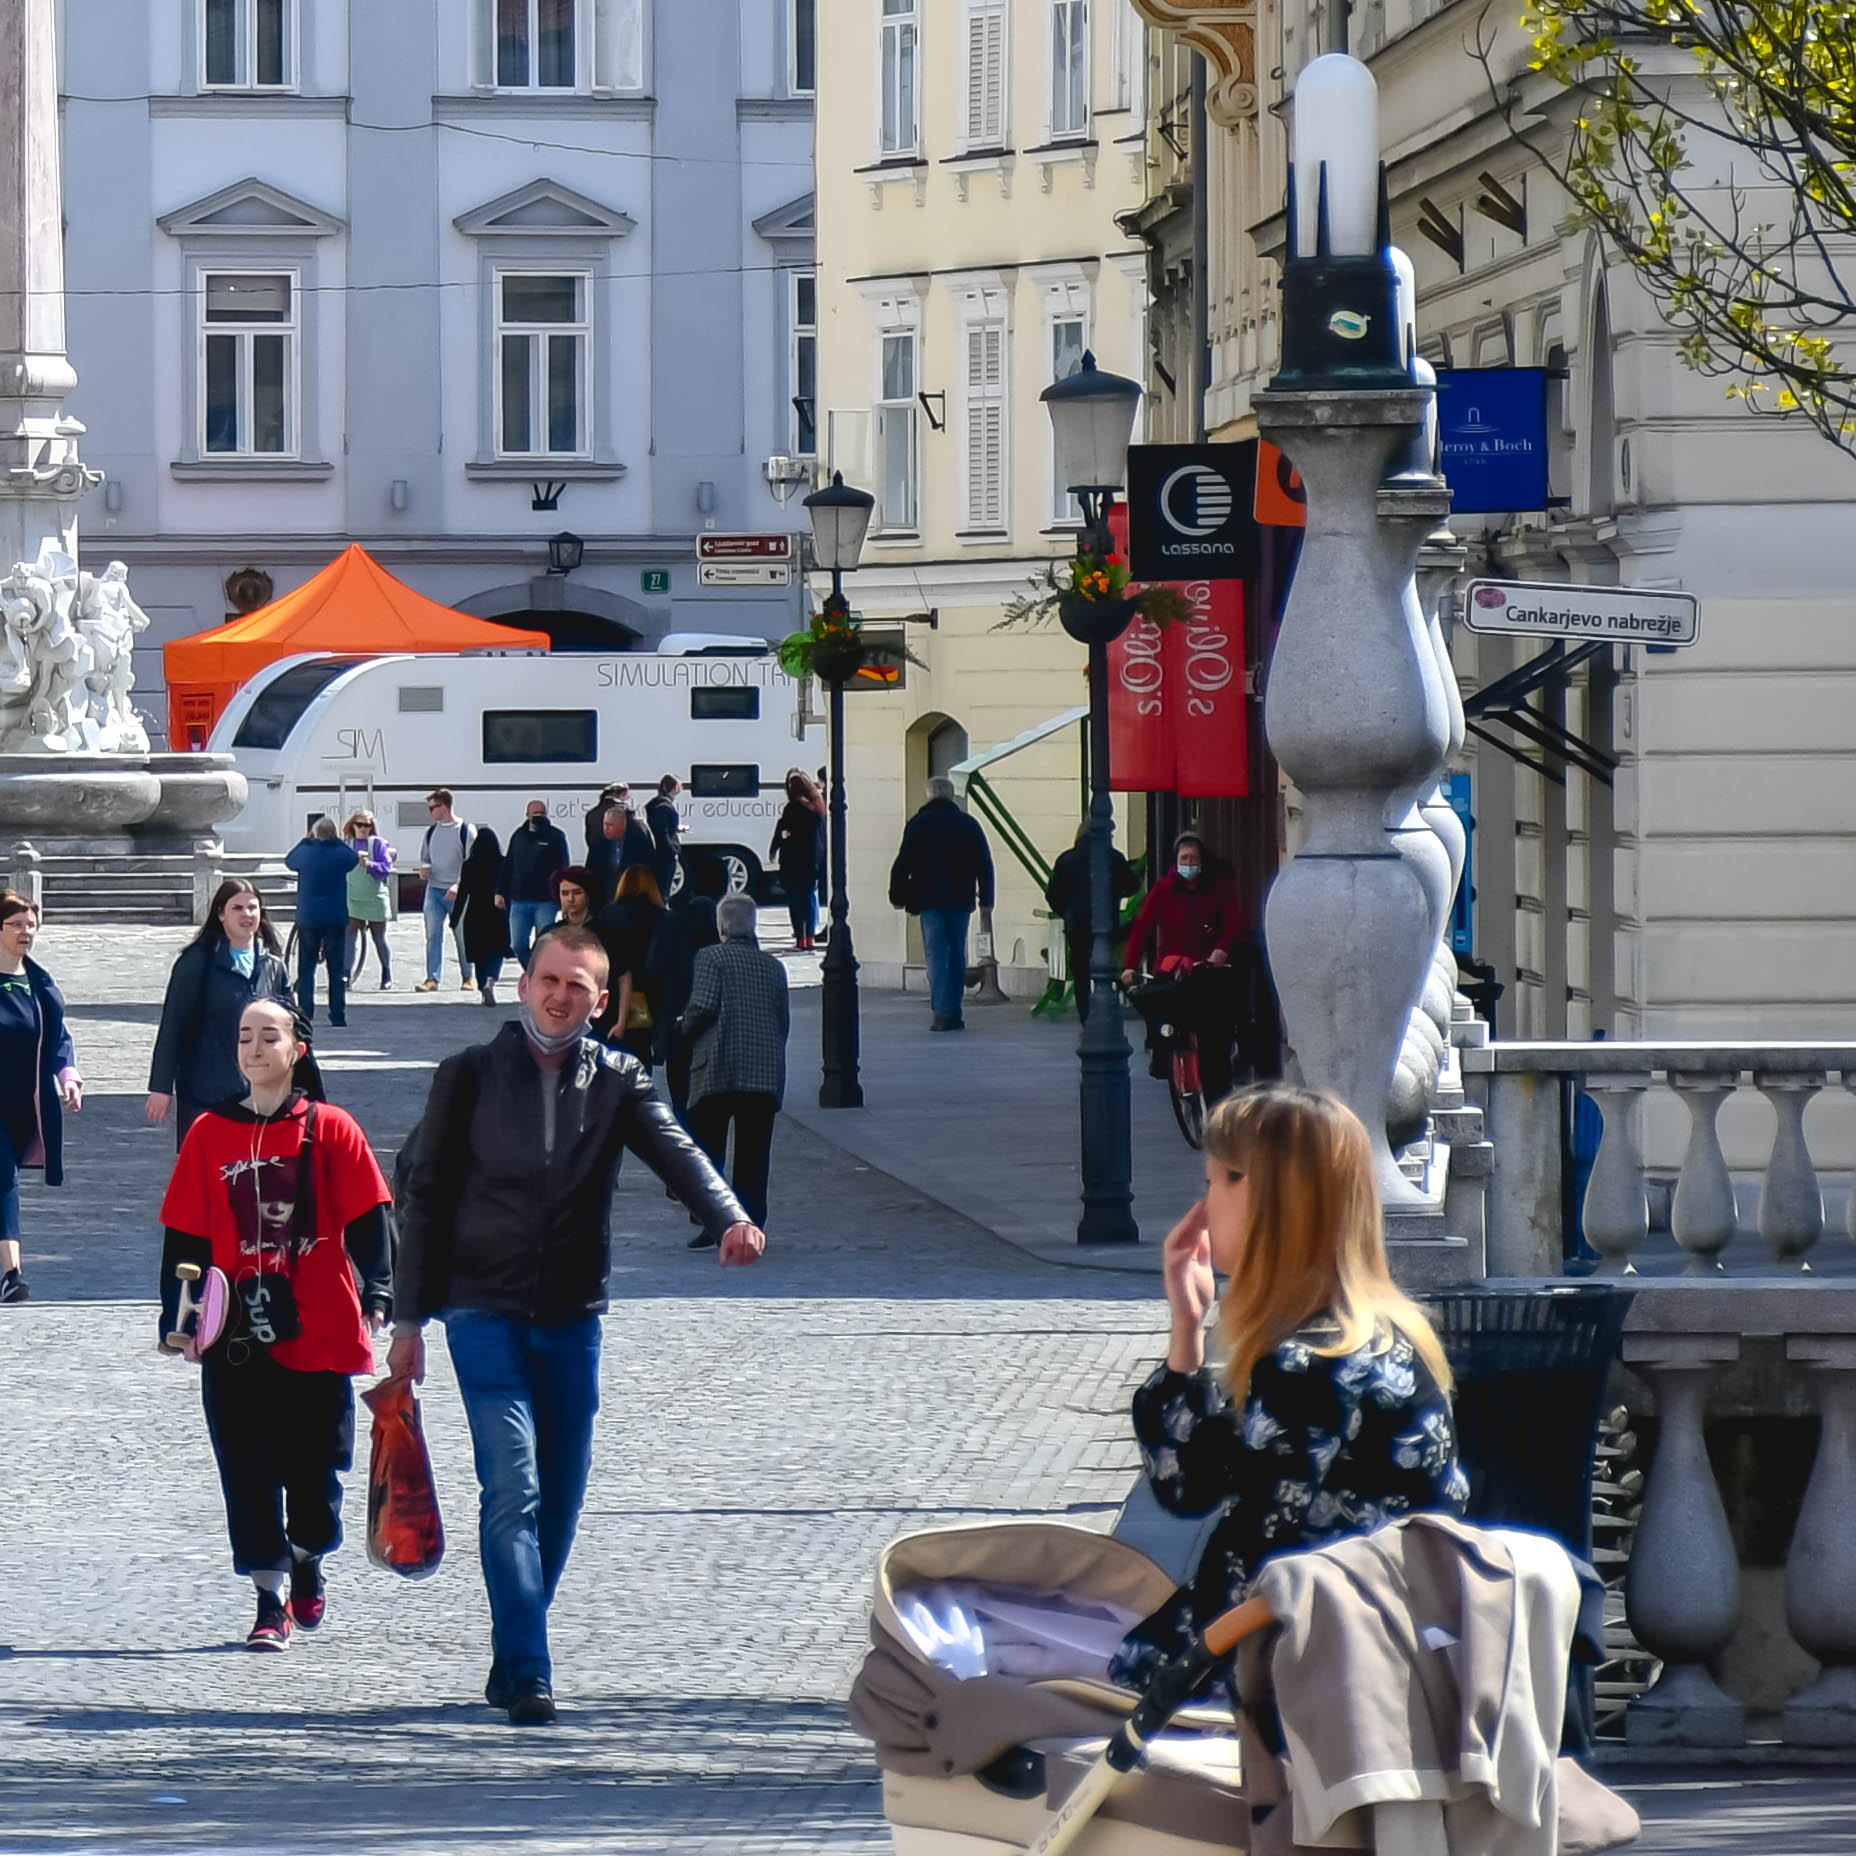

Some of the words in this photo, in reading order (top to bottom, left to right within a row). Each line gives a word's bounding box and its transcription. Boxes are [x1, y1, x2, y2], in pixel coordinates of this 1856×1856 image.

[1493, 438, 1532, 452] Boch
[1505, 606, 1603, 630] Cankarjevo
[1607, 613, 1682, 637] nabrežje
[597, 662, 749, 687] SIMULATION
[245, 1287, 277, 1343] Sup
